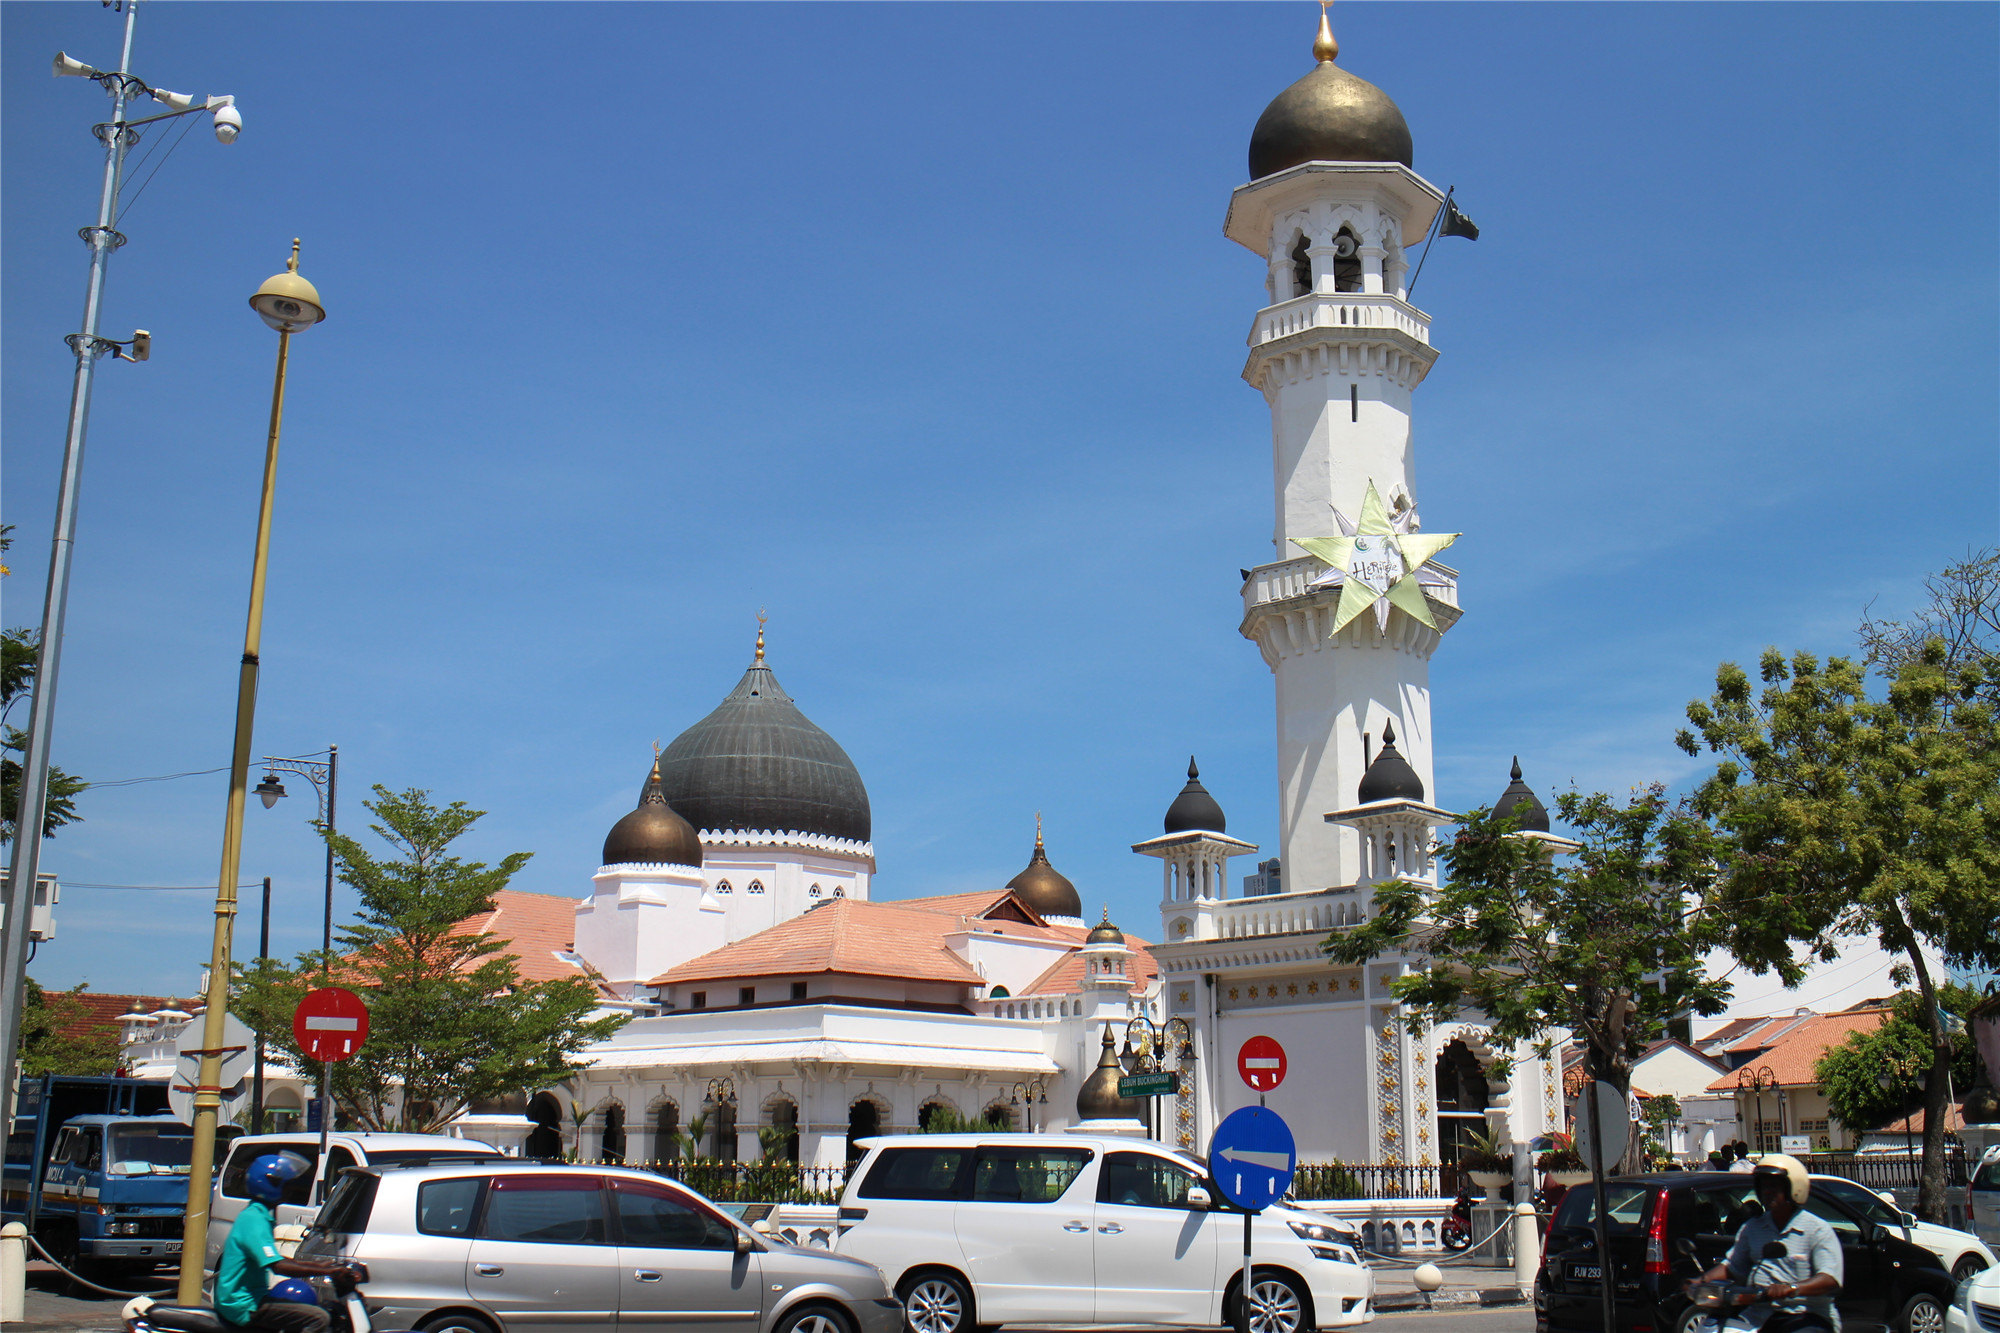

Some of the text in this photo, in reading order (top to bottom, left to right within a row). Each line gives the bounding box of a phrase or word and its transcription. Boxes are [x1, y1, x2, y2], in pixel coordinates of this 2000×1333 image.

[1121, 1074, 1169, 1087] LEBUH BUCKINGHAM
[1574, 1266, 1587, 1278] PJW
